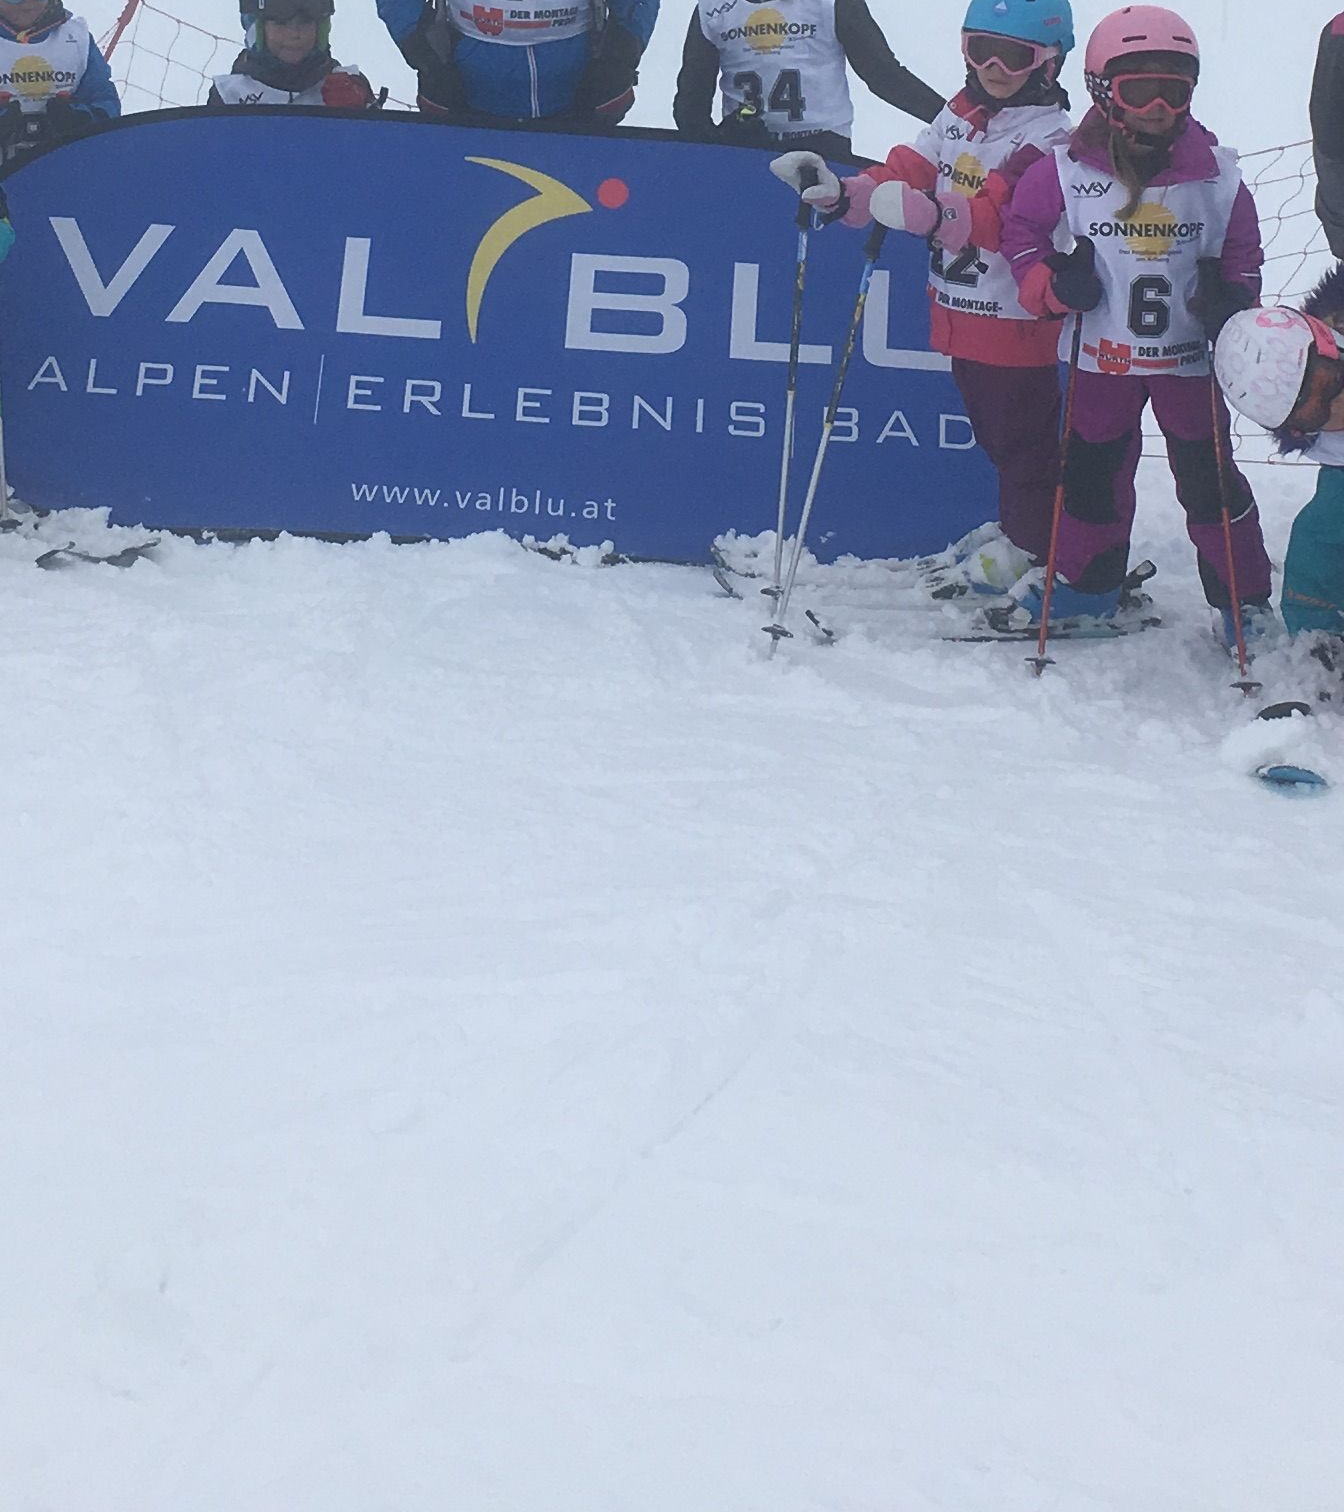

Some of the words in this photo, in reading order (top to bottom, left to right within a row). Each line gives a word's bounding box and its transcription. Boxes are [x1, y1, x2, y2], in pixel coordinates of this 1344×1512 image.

[510, 10, 531, 19] DER
[720, 22, 817, 42] SONNENKOPF
[733, 68, 807, 123] 34
[1071, 181, 1113, 197] WSV
[1088, 221, 1205, 238] SONNENKOPF
[48, 217, 442, 339] VAL
[564, 252, 953, 372] BLU
[951, 294, 1003, 313] MONTAGE-
[1127, 274, 1173, 339] 6
[1138, 345, 1159, 357] DER
[27, 355, 291, 405] ALPEN
[347, 375, 766, 437] ERLEBNIS
[823, 406, 977, 450] BAD
[351, 483, 617, 520] www.valblu.at
